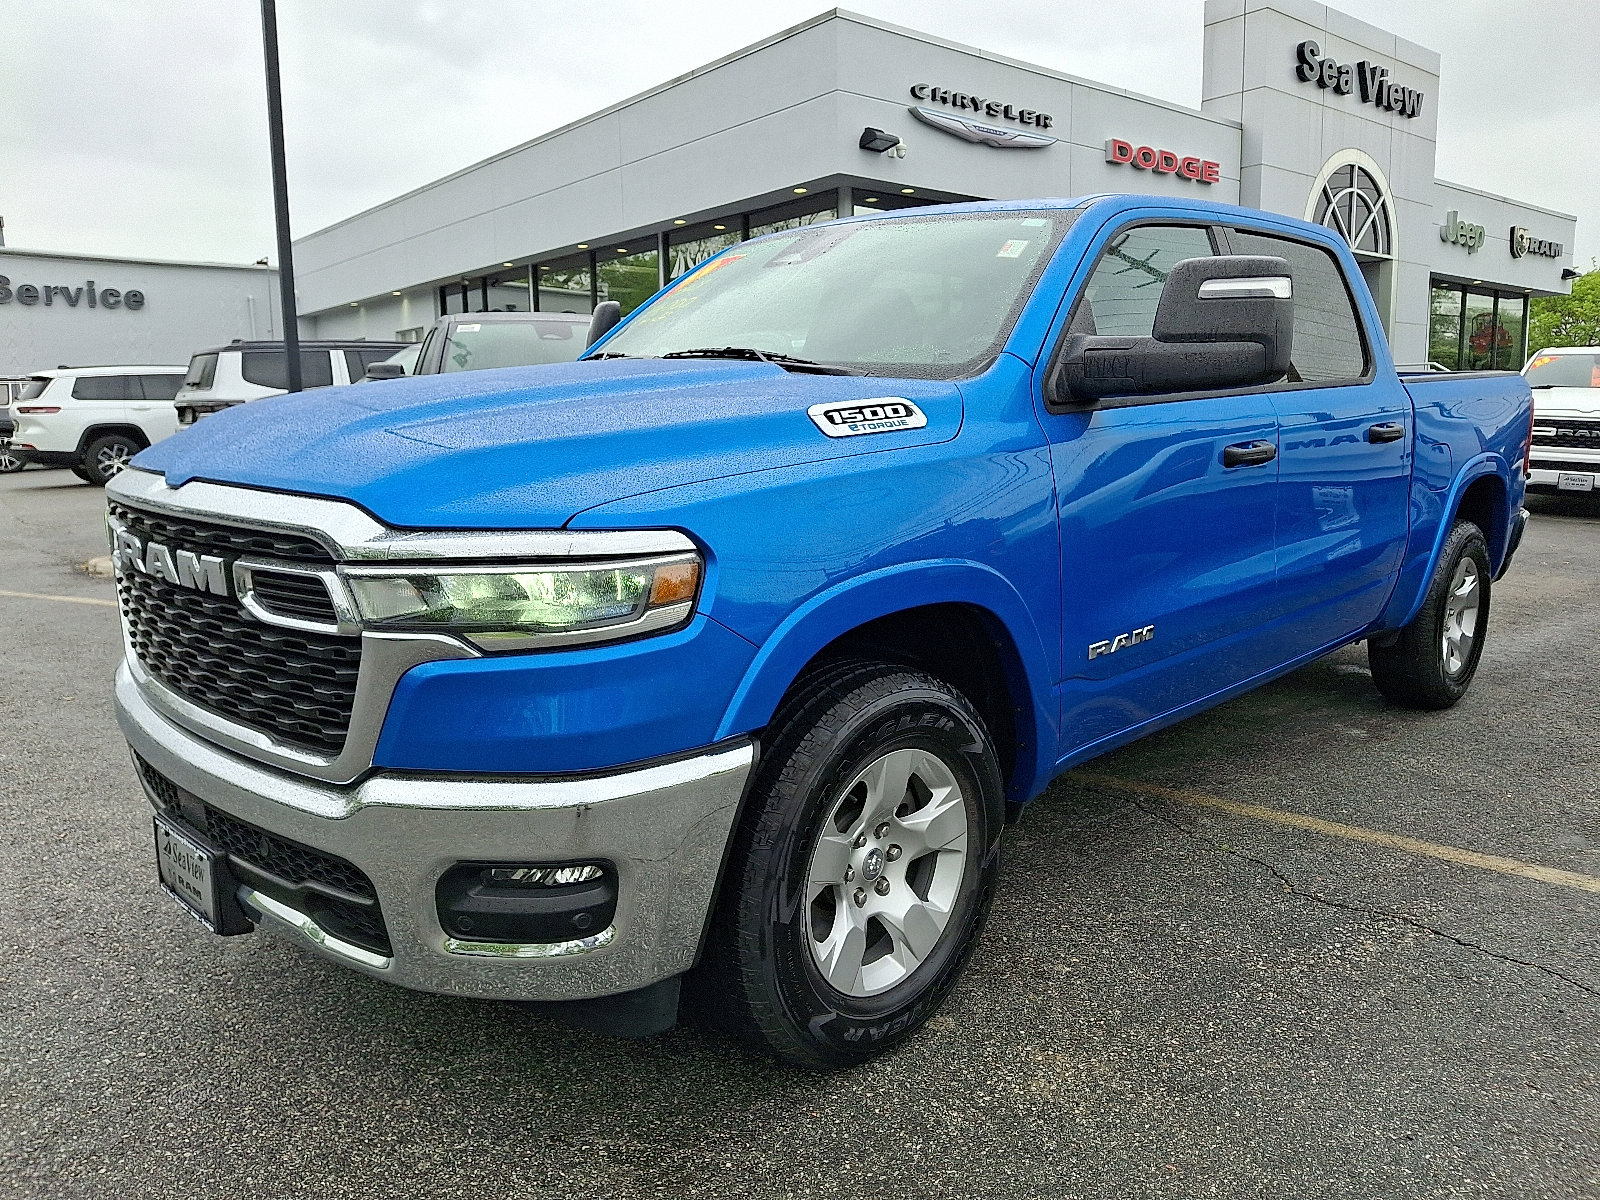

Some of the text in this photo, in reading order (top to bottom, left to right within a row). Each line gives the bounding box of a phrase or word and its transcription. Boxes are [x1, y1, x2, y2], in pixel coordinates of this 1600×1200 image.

[1296, 40, 1424, 118] Sea View
[910, 82, 1054, 129] CHRYSLER
[1106, 138, 1220, 184] DODGE
[1440, 210, 1486, 254] Jeep
[1529, 237, 1564, 258] RAM
[825, 404, 908, 425] 1500
[117, 528, 228, 597] RAM
[1088, 624, 1155, 660] RAM
[177, 874, 202, 900] RAM
